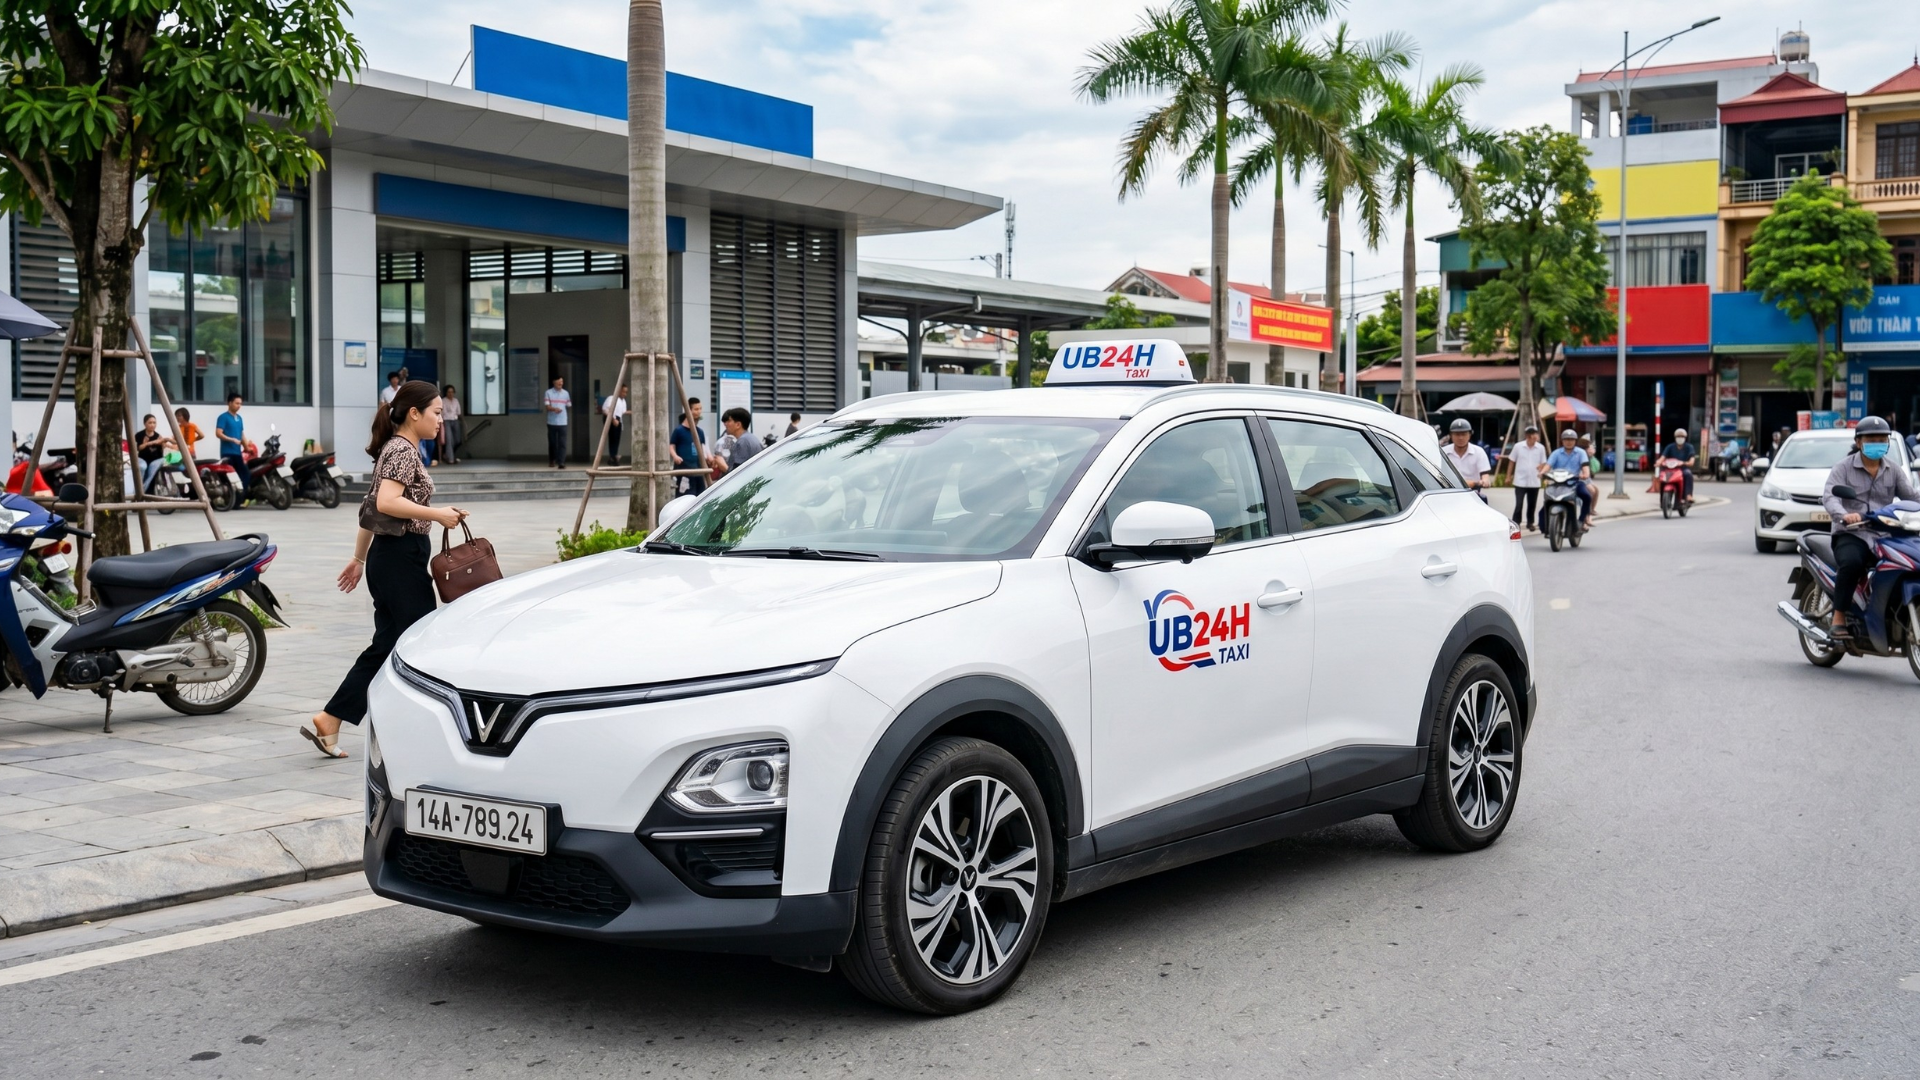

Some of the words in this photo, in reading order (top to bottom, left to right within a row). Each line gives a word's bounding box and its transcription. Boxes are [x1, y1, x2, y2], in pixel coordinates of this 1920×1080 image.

[1062, 344, 1156, 369] UB24H
[1149, 602, 1250, 656] UB24H
[1218, 642, 1250, 664] TAXI
[417, 797, 534, 845] 14A-789.24
